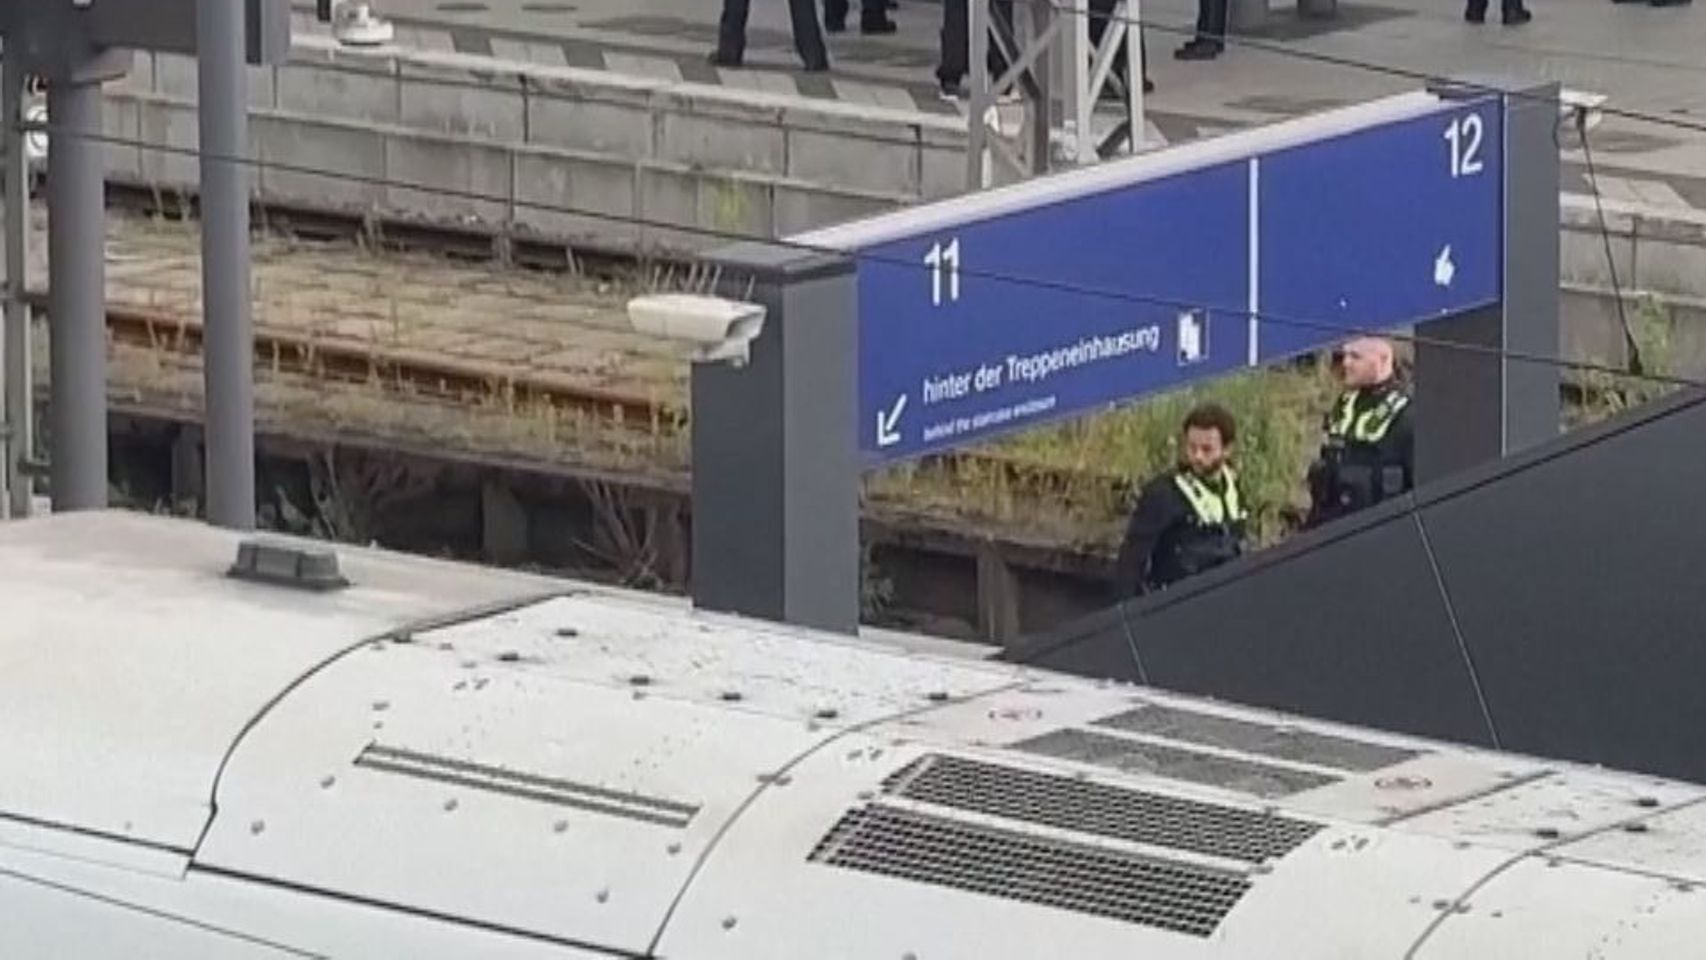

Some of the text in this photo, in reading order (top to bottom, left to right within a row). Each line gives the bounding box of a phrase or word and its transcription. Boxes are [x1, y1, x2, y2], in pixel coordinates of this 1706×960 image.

[1444, 112, 1484, 178] 12
[923, 237, 961, 306] 11
[923, 324, 1161, 405] hinter der Treppeneinhausung
